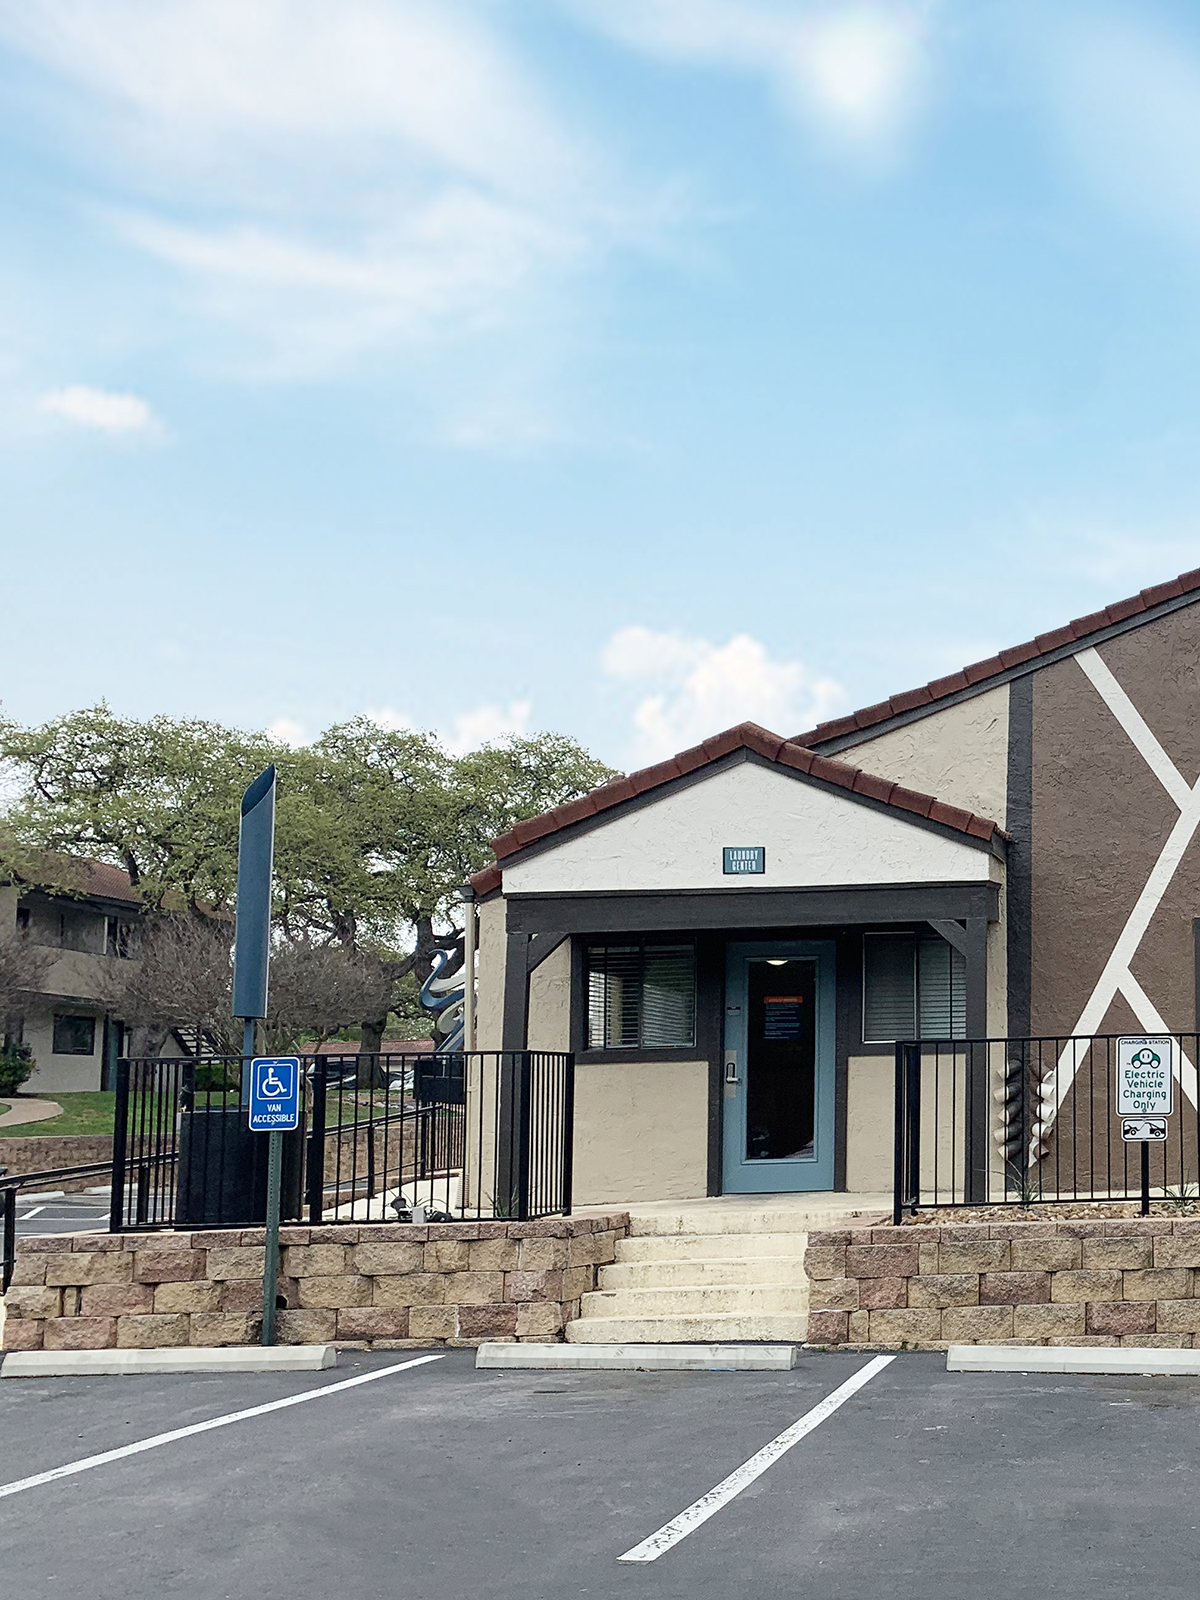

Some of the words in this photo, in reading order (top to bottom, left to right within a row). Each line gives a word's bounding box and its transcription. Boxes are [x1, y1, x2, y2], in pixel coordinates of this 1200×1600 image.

[729, 850, 758, 860] LAUNDRY
[732, 861, 756, 871] CENTER
[1124, 1070, 1165, 1079] Electric
[1127, 1080, 1163, 1088] Vehicle
[1123, 1090, 1167, 1100] Charging
[266, 1104, 282, 1112] VAN
[1133, 1100, 1156, 1110] Only
[252, 1114, 295, 1123] ACCESSIBLE
